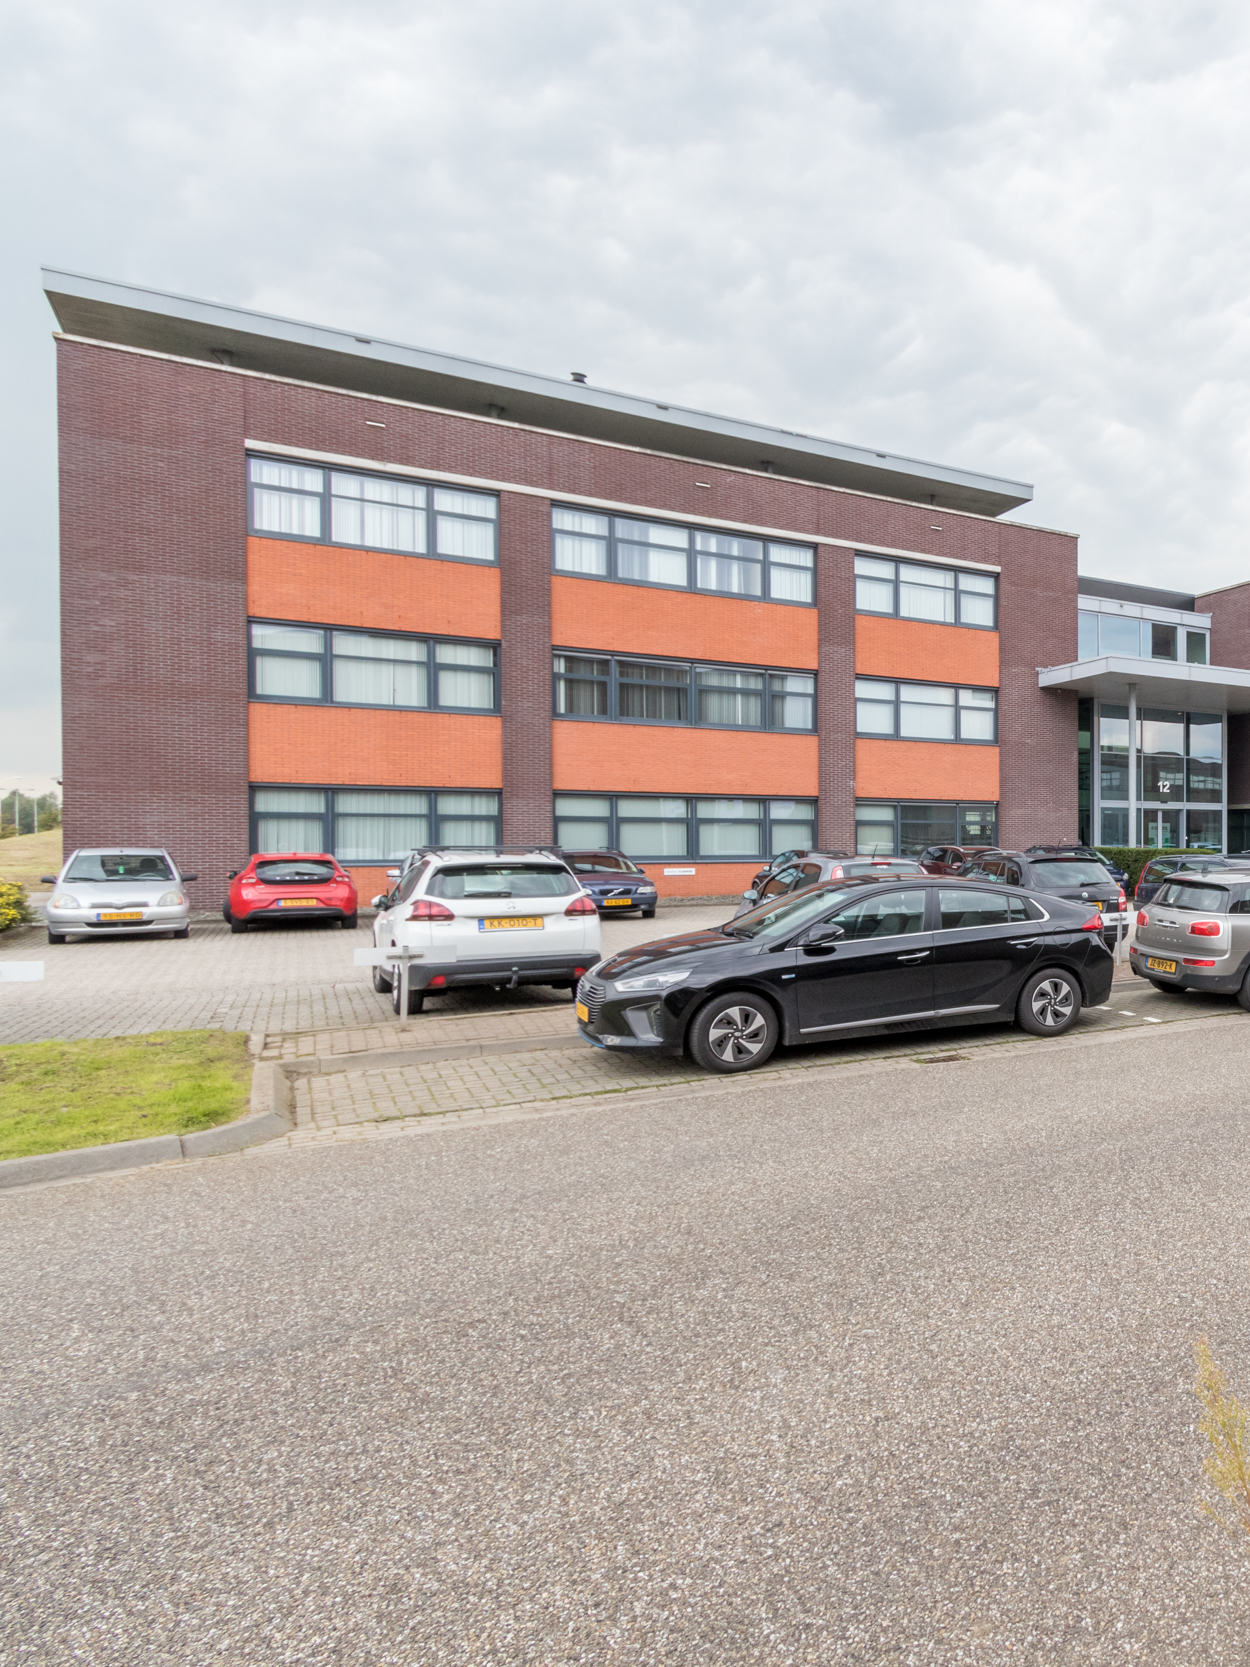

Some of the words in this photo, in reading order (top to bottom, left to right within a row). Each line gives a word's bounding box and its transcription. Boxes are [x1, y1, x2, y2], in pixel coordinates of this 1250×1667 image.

[1157, 781, 1170, 793] 12
[489, 918, 538, 928] KK-010-T
[1149, 959, 1173, 971] JZ-892-K
